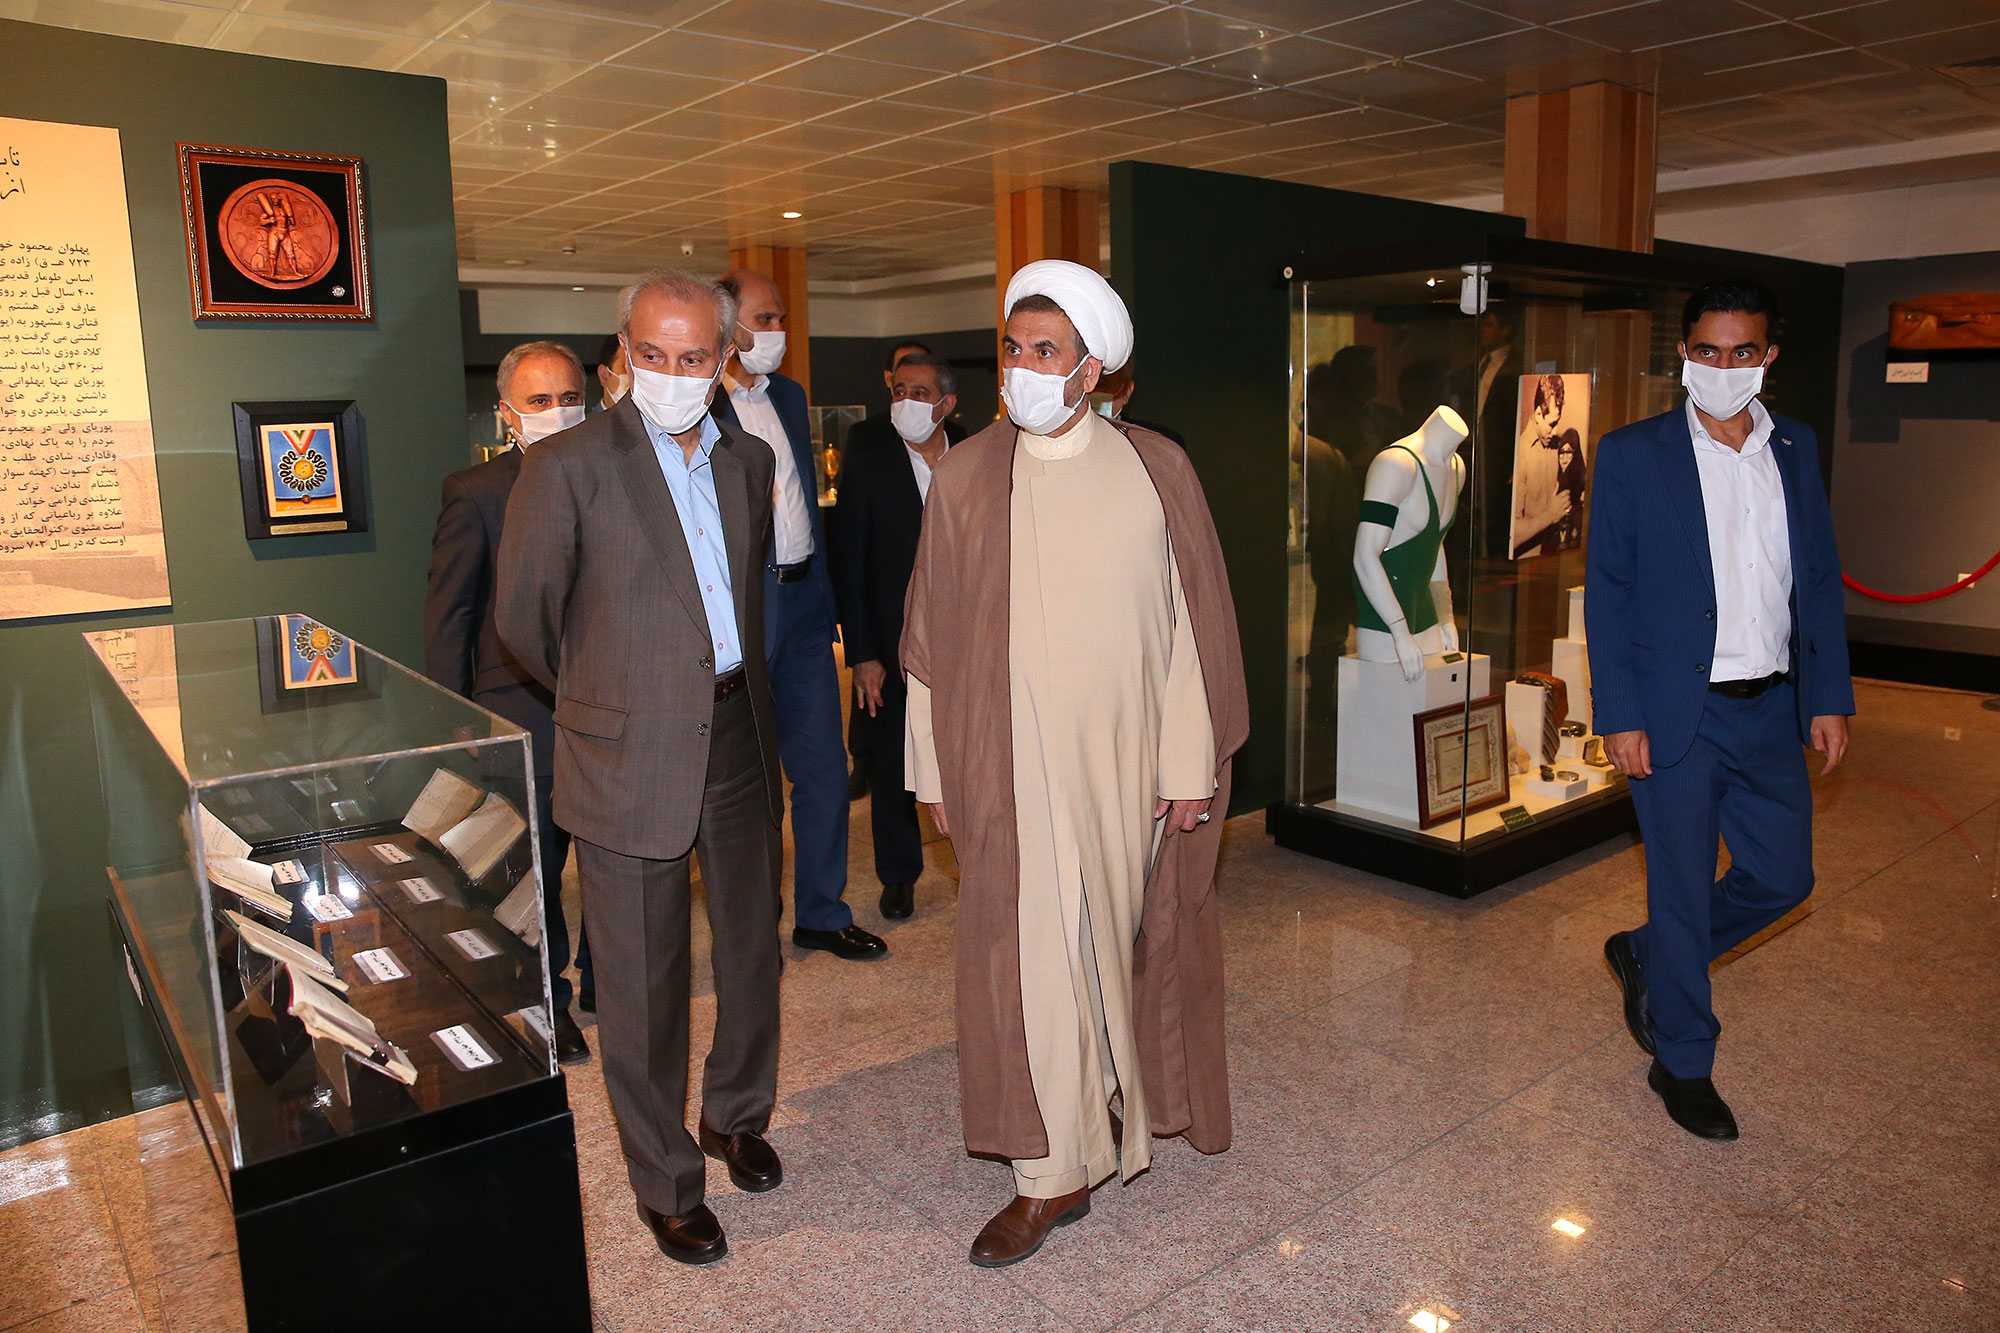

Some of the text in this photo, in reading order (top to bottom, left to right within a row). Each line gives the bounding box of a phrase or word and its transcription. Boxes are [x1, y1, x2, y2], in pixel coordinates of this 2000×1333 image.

[9, 146, 19, 166] تا
[0, 178, 25, 199] از
[19, 242, 53, 252] محمود
[58, 243, 90, 255] پهلوان
[10, 256, 30, 267] زاده
[34, 272, 61, 284] طومار
[65, 274, 93, 284] اساس
[19, 290, 27, 298] بر
[31, 286, 50, 298] قبل
[54, 288, 75, 298] سال
[8, 302, 96, 315] عارف قرن هشتم
[16, 318, 26, 327] به
[30, 317, 63, 328] مشهور
[66, 320, 71, 328] و
[14, 334, 20, 342] و
[21, 332, 50, 343] گرفت
[70, 332, 100, 344] کشتی
[20, 347, 50, 355] داشت
[54, 349, 80, 358] دوزی
[82, 347, 102, 356] کلاه
[20, 362, 28, 372] او
[30, 364, 40, 373] به
[42, 361, 50, 373] را
[52, 362, 67, 373] فن
[68, 362, 87, 371] ۳۶۰
[90, 362, 104, 373] نیز
[9, 376, 45, 388] پهلوانی
[49, 376, 69, 387] تنها
[5, 391, 107, 403] داشتن ویژگی های
[21, 409, 26, 417] و
[41, 424, 52, 434] در
[58, 423, 76, 434] ولی
[40, 438, 59, 448] پاک
[64, 440, 74, 448] به
[79, 437, 87, 448] را
[91, 438, 115, 447] مردم
[13, 453, 37, 464] طلب
[60, 466, 92, 477] کسوت
[95, 466, 118, 477] پیش
[18, 482, 39, 493] ترک
[90, 479, 120, 490] دشنام
[79, 494, 121, 506] سربلندی
[10, 512, 18, 523] از
[23, 512, 35, 520] که
[41, 509, 81, 522] رباعیاتی
[86, 512, 94, 520] بر
[98, 508, 122, 519] علاوه
[71, 524, 101, 534] مثنوی
[102, 521, 125, 530] است
[26, 540, 46, 548] ۷۰۳
[50, 539, 70, 550] سال
[73, 538, 84, 549] در
[86, 537, 97, 546] که
[99, 536, 126, 546] اوست
